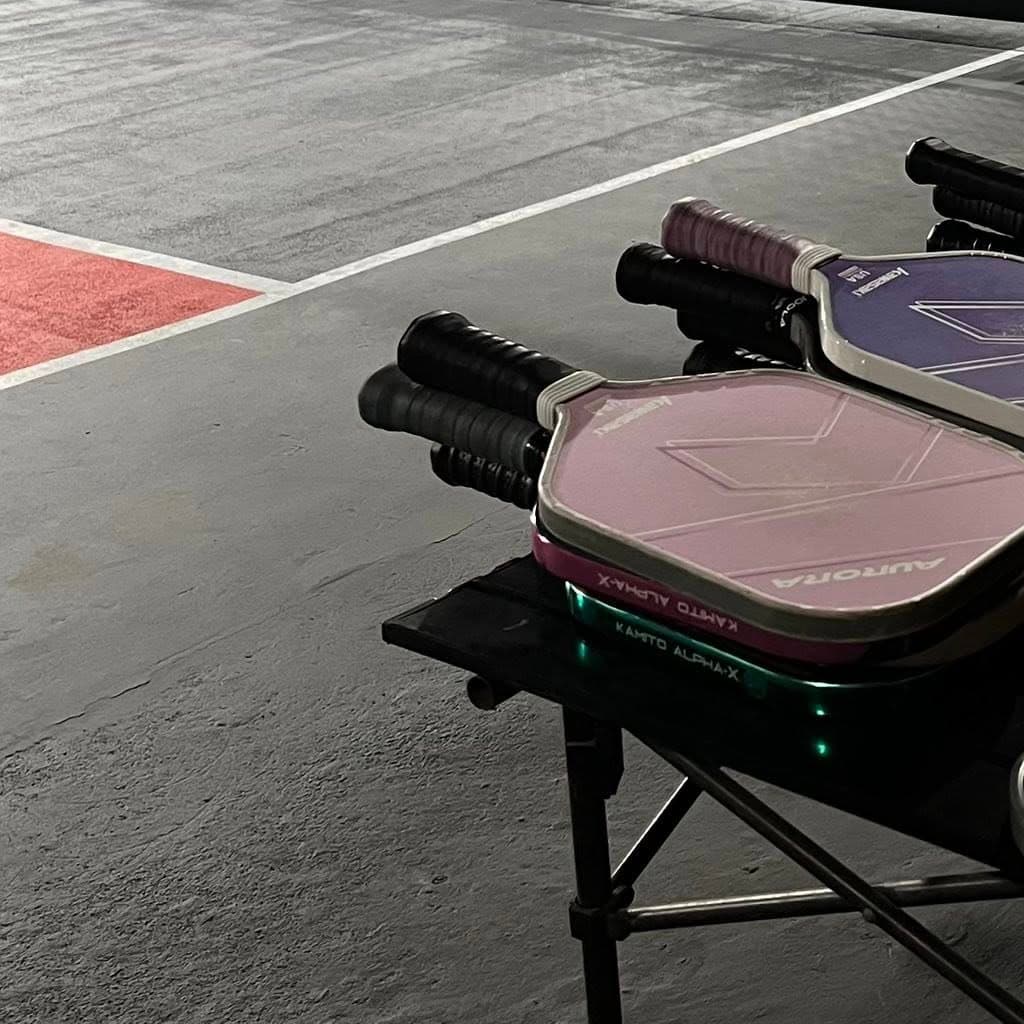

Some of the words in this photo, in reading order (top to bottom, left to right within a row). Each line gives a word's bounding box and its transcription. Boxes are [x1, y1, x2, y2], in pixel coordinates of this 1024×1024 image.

[597, 572, 672, 607] ALPHA-X
[771, 557, 946, 589] AURORA
[677, 601, 739, 632] KAMITO
[615, 620, 668, 651] KAMITO
[673, 645, 740, 682] ALPHA-X
